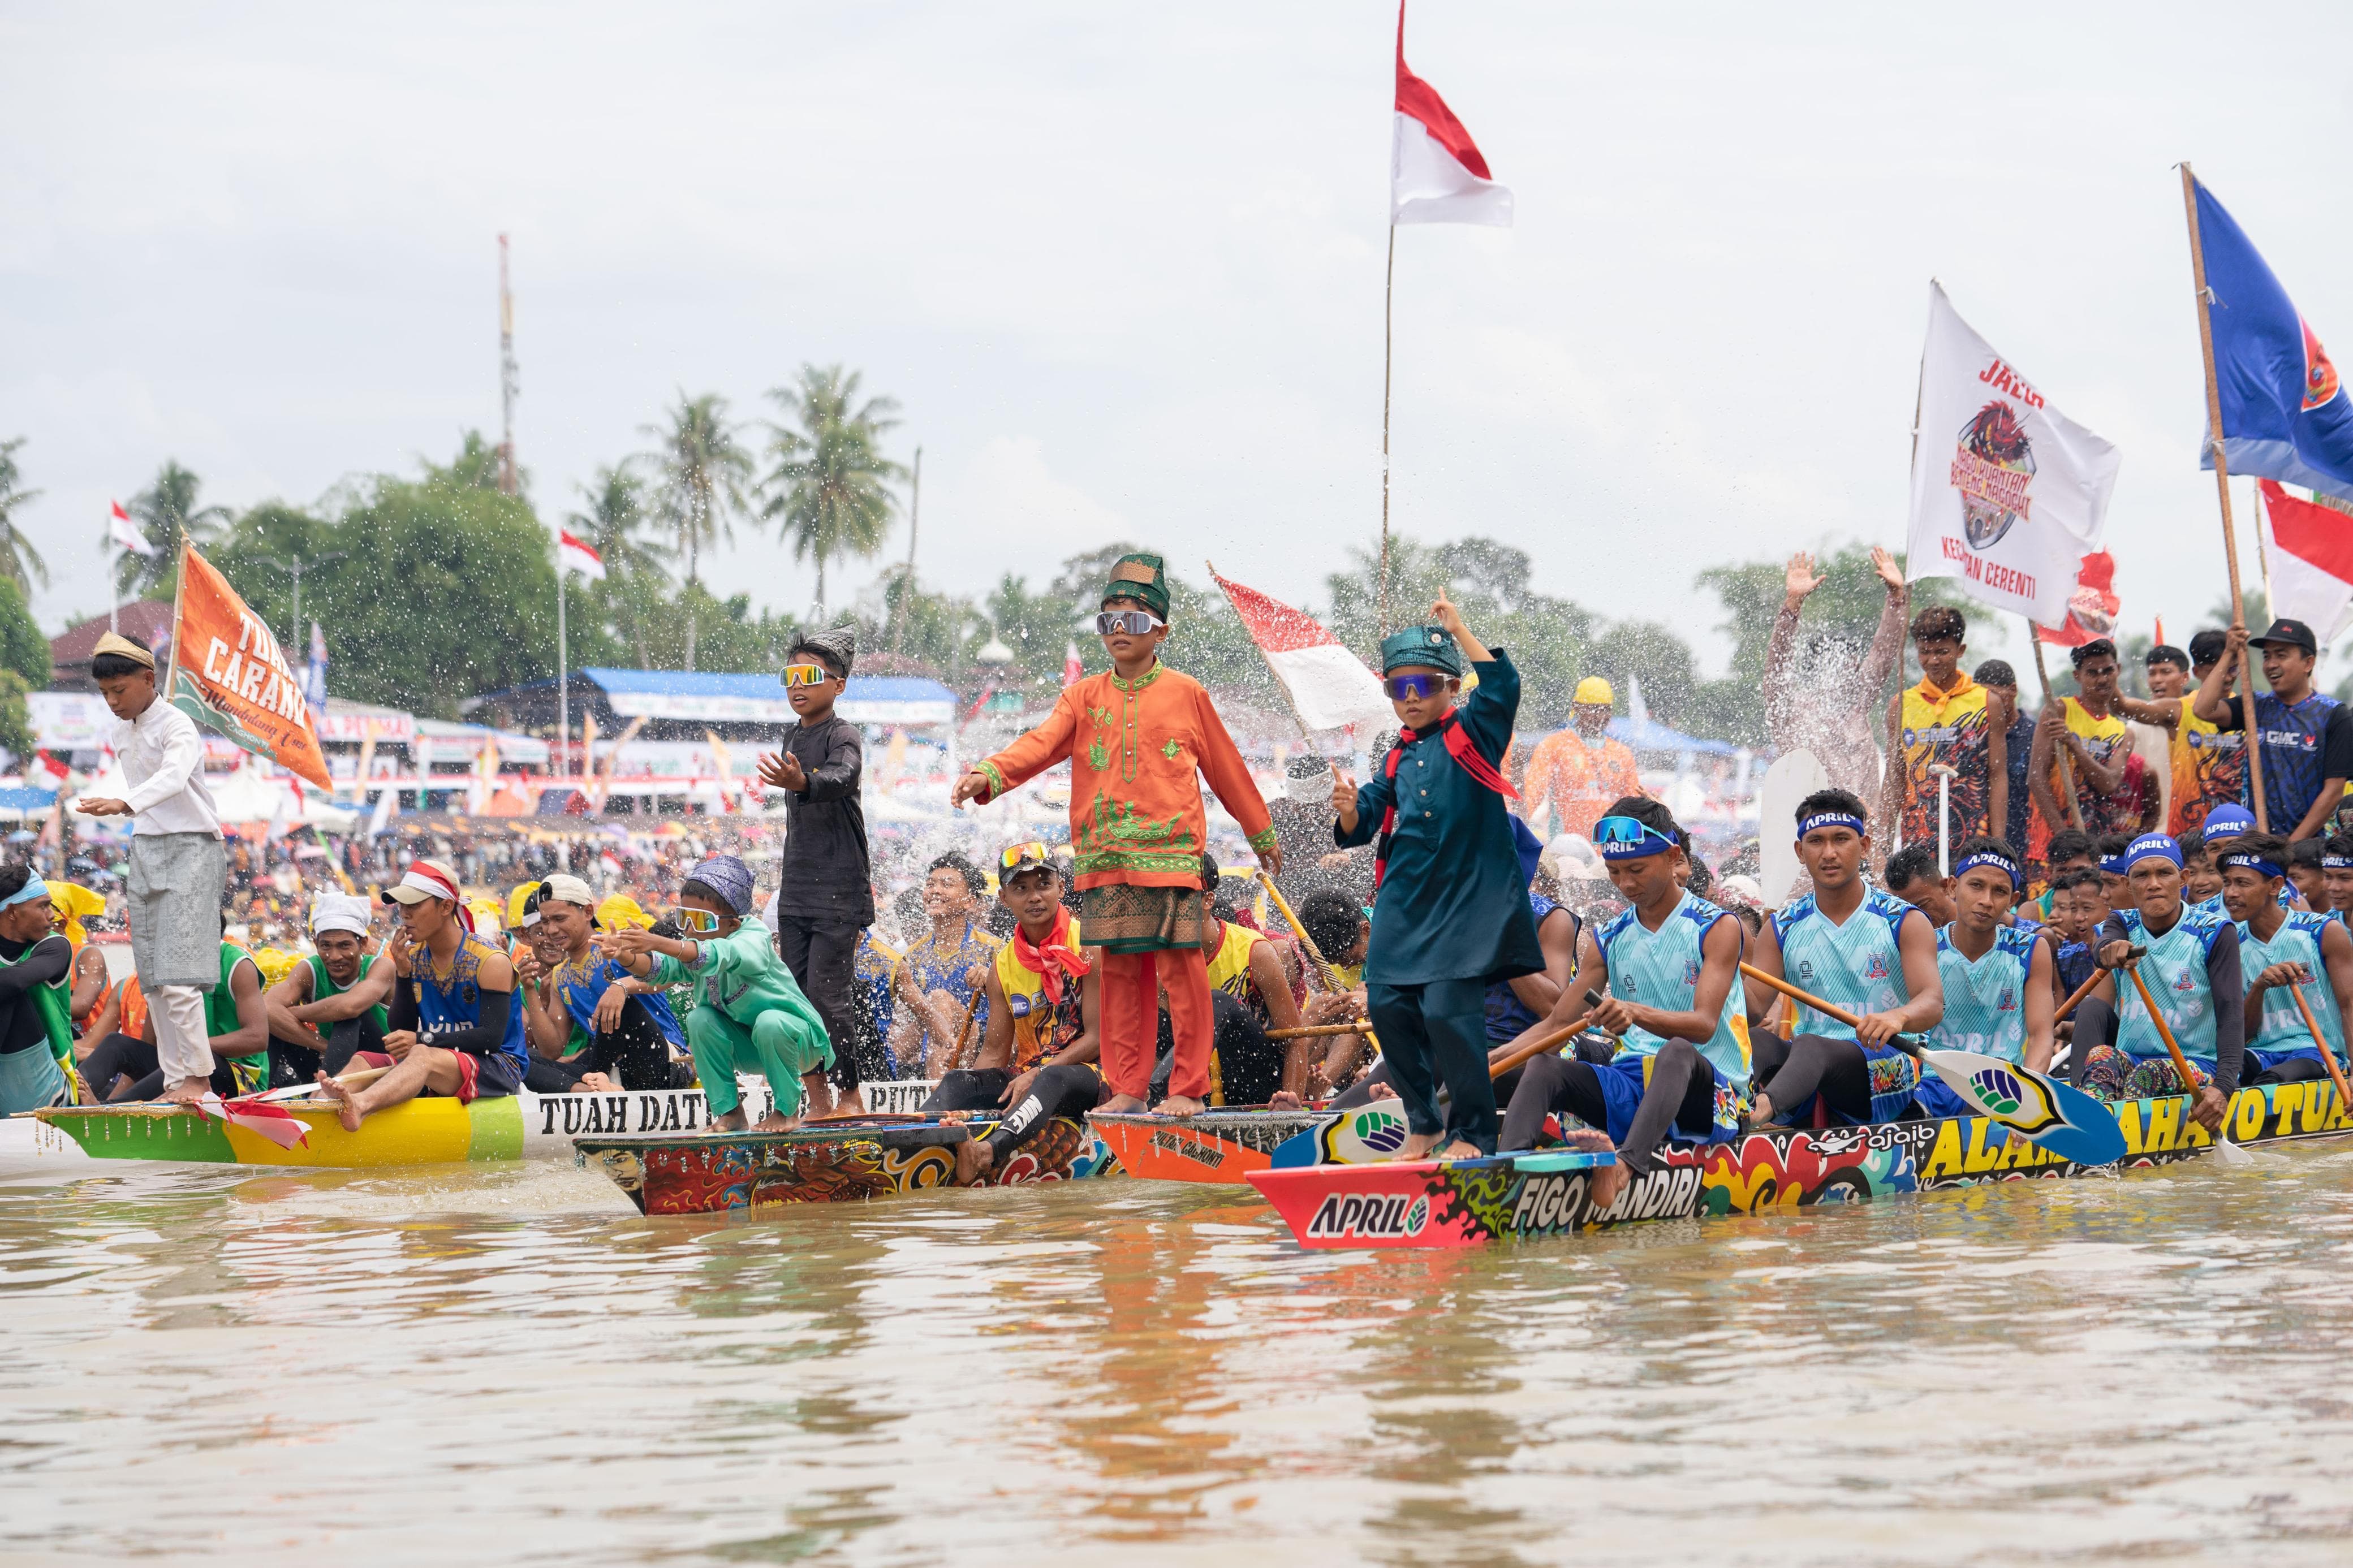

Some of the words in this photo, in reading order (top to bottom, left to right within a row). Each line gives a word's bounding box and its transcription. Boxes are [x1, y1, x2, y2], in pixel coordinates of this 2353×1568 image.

[1979, 460, 2031, 494] KUANTAN
[1985, 561, 2036, 600] CERENTI
[1917, 727, 1958, 742] GMC
[2204, 732, 2243, 749] GMC
[2266, 730, 2300, 746] GMC
[1806, 813, 1851, 831] APRIL
[2205, 821, 2242, 836] APRIL
[1602, 841, 1635, 853] PRIL
[2128, 840, 2164, 858] APRIL
[1968, 854, 2010, 870] APRIL
[2226, 855, 2251, 866] PRIL
[870, 1086, 933, 1114] PUT
[539, 1096, 628, 1135] TUAH
[1008, 1094, 1043, 1134] NIKE
[2104, 1087, 2267, 1155] AHAYO
[1868, 1124, 1935, 1150] ajaib
[1510, 1174, 1584, 1229] FIGO
[1309, 1196, 1407, 1235] APRIL
